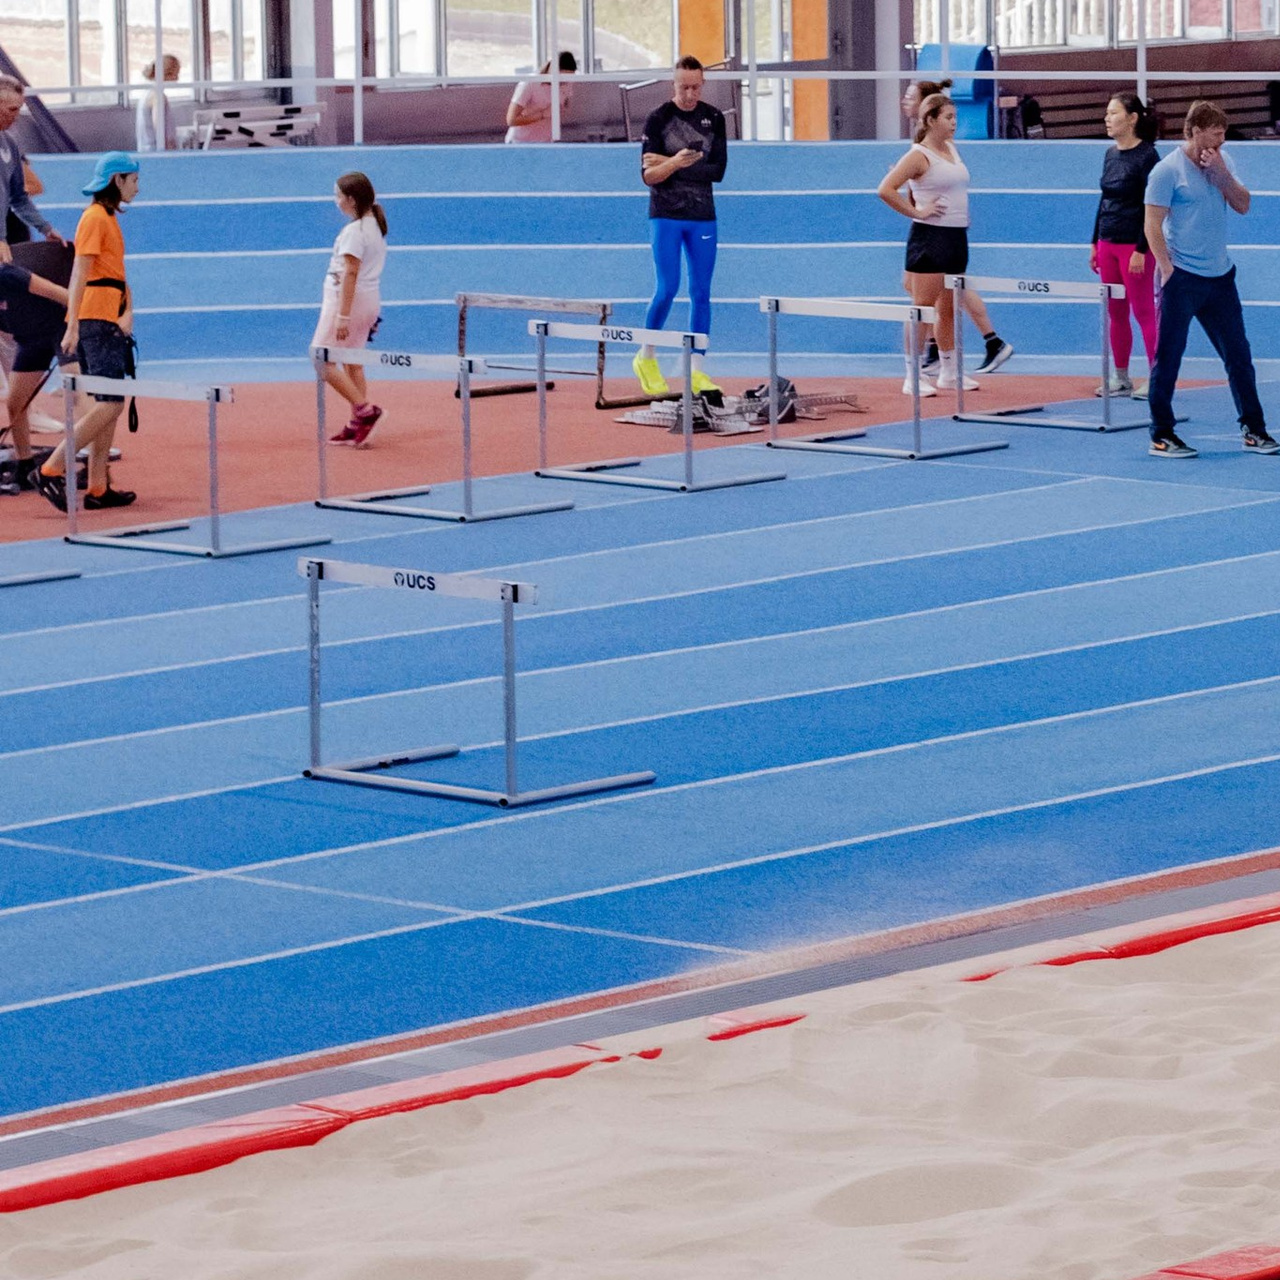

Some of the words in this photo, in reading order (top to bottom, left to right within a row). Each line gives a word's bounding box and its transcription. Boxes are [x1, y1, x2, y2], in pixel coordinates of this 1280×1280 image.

[1027, 282, 1050, 293] UCS
[611, 329, 633, 341] UCS
[390, 354, 412, 367] UCS
[406, 573, 436, 591] UCS
